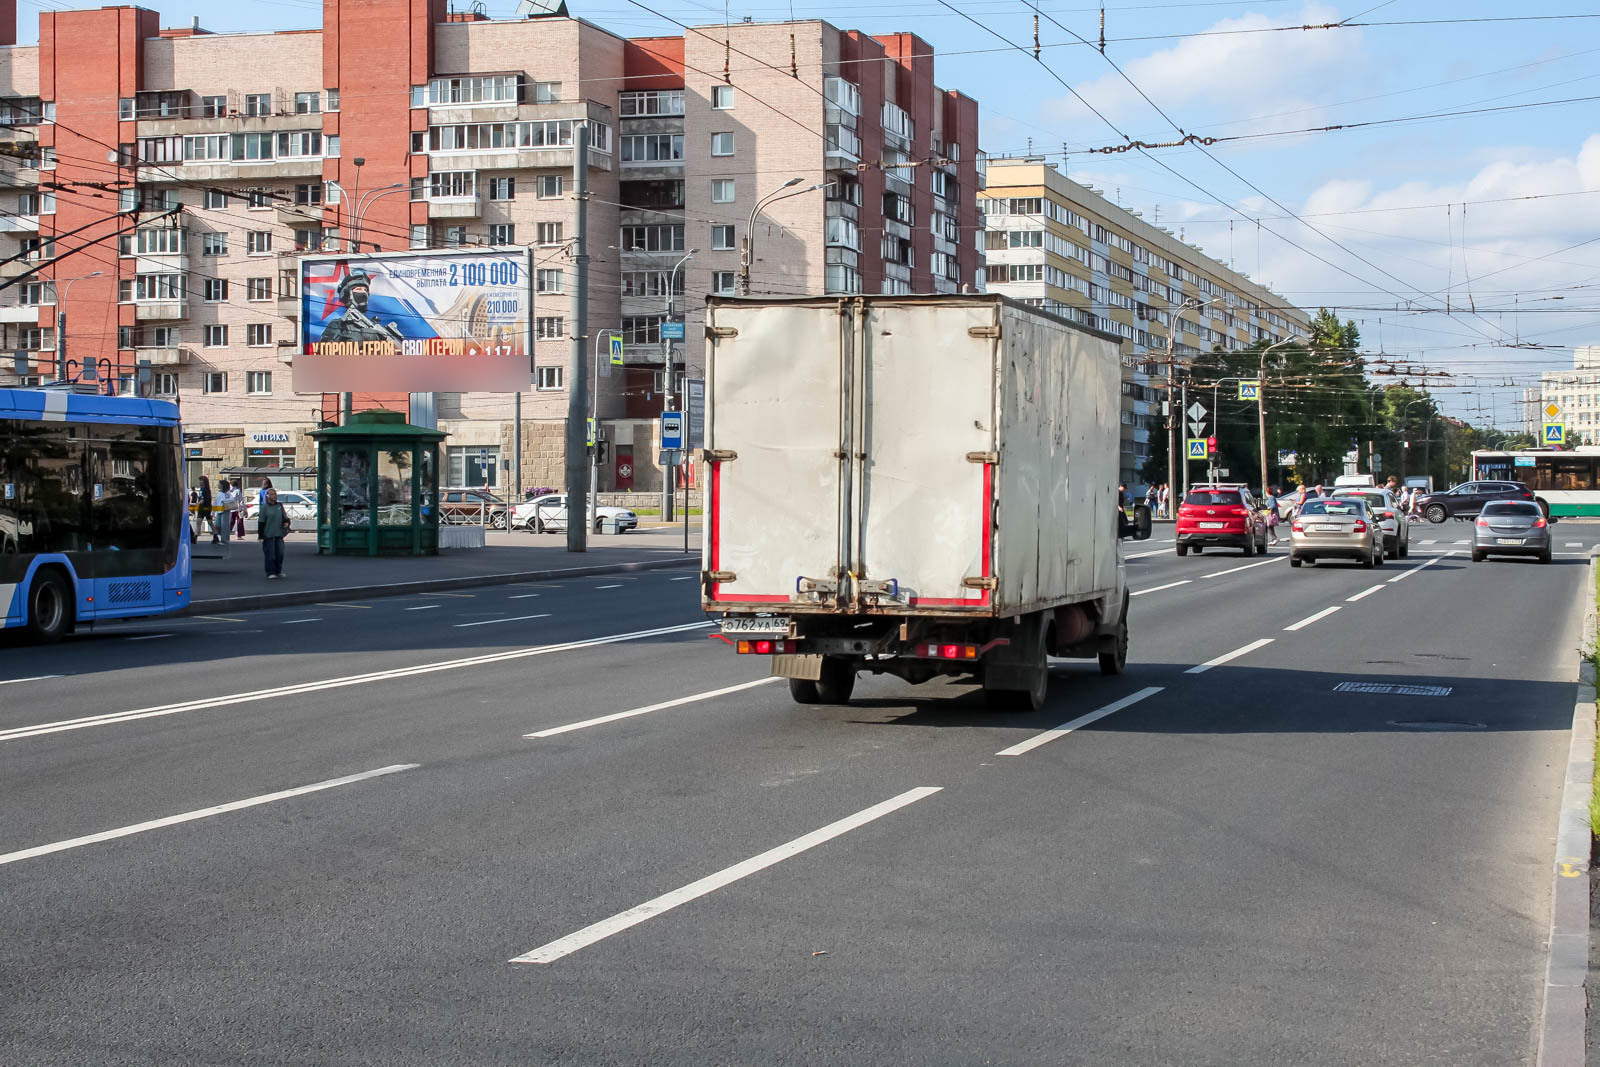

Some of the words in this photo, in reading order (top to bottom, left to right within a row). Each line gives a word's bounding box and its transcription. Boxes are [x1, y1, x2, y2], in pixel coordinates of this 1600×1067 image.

[448, 263, 458, 287] 2
[461, 262, 486, 287] 100
[490, 261, 518, 286] 000
[416, 278, 447, 288] ВЫПЛАТА
[487, 300, 501, 314] 210
[502, 299, 518, 313] 000
[402, 338, 429, 355] СВОИ
[253, 433, 289, 442] ОПТИКА
[774, 618, 786, 628] 69
